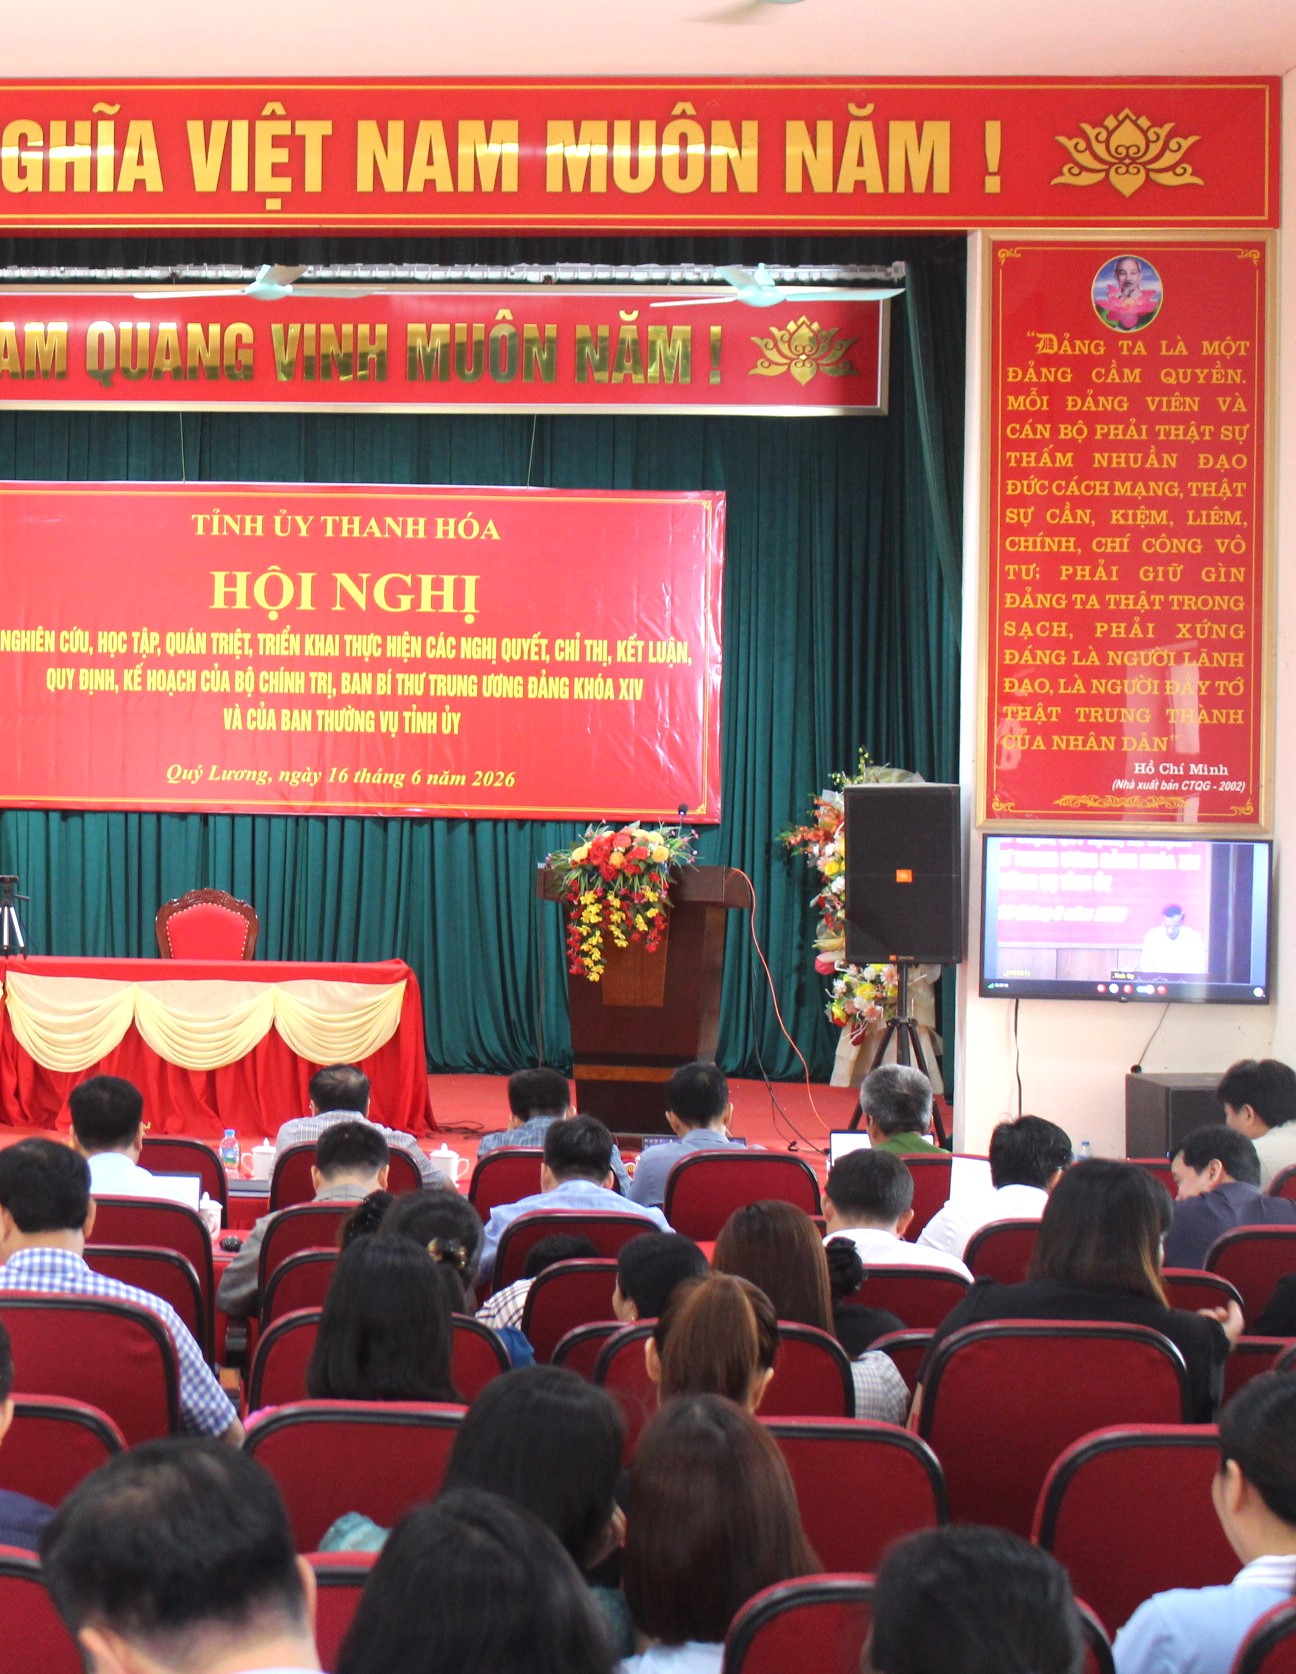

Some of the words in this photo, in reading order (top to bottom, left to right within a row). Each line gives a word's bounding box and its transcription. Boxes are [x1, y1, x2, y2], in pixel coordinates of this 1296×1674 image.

[186, 100, 333, 211] VIỆT
[355, 119, 519, 193] NAM
[545, 100, 759, 194] MUÔN
[784, 102, 951, 194] NĂM
[984, 120, 1002, 194] !
[85, 321, 254, 387] QUANG
[270, 322, 389, 383] VINH
[406, 308, 557, 384] MUÔN
[574, 309, 692, 384] NĂM
[708, 326, 722, 385] !
[1007, 360, 1072, 384] ĐẢNG
[1091, 360, 1141, 384] CẦM
[1008, 388, 1049, 412] MỖI
[1066, 388, 1129, 412] ĐẢNG
[1146, 392, 1199, 412] VIÊN
[1217, 394, 1247, 412] VÀ
[1005, 420, 1052, 440] CÁN
[1057, 420, 1089, 442] BỘ
[1095, 418, 1147, 440] PHẢI
[1155, 421, 1215, 443] THẬT
[1220, 424, 1249, 443] SỰ
[1005, 444, 1074, 468] THẤM
[1093, 446, 1177, 469] NHUẦN
[1200, 453, 1248, 471] ĐẠO
[192, 508, 264, 536] TỈNH
[273, 510, 315, 537] ỦY
[320, 516, 426, 538] THANH
[436, 512, 500, 540] HÓA
[1005, 533, 1081, 553] CHÍNH,
[1092, 534, 1129, 553] CHÍ
[1142, 534, 1202, 554] CÔNG
[1217, 535, 1246, 554] VÔ
[1060, 558, 1119, 582] PHẢI
[1139, 563, 1183, 582] GIỮ
[1202, 564, 1245, 583] GÌN
[209, 565, 316, 621] HỘI
[331, 572, 480, 624] NGHỊ
[1005, 587, 1067, 609] ĐẢNG
[1072, 594, 1100, 609] TA
[1106, 590, 1165, 611] THẬT
[1169, 595, 1244, 610] TRONG
[1004, 620, 1073, 640] SẠCH,
[1094, 616, 1155, 638] PHẢI
[1177, 619, 1245, 640] XỨNG
[0, 627, 55, 652] NGHIÊN
[60, 628, 94, 653] CỨU,
[98, 632, 128, 658] HỌC
[132, 628, 162, 658] TẬP,
[166, 630, 207, 656] QUÁN
[211, 629, 252, 658] TRIỆT,
[258, 626, 301, 655] TRIỂN
[305, 634, 340, 656] KHAI
[345, 634, 382, 660] THỰC
[386, 632, 422, 662] HIỆN
[426, 633, 456, 658] CÁC
[460, 637, 497, 663] NGHỊ
[502, 633, 550, 662] QUYẾT,
[555, 632, 580, 660] CHỈ
[585, 640, 611, 664] THỊ,
[617, 638, 643, 662] KẾT
[649, 636, 692, 669] LUẬN,
[46, 668, 74, 690] QUY
[79, 669, 118, 694] ĐỊNH,
[124, 665, 142, 691] KẾ
[148, 670, 196, 696] HOẠCH
[201, 664, 230, 691] CỦA
[235, 668, 255, 693] BỘ
[259, 669, 306, 693] CHÍNH
[310, 672, 337, 697] TRỊ,
[342, 672, 373, 694] BAN
[376, 671, 392, 695] BÍ
[396, 672, 427, 696] THƯ
[428, 674, 478, 697] TRUNG
[482, 674, 524, 698] ƯƠNG
[527, 670, 570, 698] ĐẢNG
[574, 676, 614, 699] KHÓA
[620, 679, 642, 699] XIV
[224, 708, 242, 729] VÀ
[248, 703, 276, 730] CỦA
[281, 710, 312, 730] BAN
[317, 706, 376, 732] THƯỜNG
[380, 712, 399, 736] VỤ
[403, 704, 438, 734] TỈNH
[442, 706, 461, 734] ỦY
[166, 764, 204, 784] Quý
[208, 765, 272, 785] Lương,
[278, 768, 323, 787] ngày
[328, 768, 350, 784] 16
[353, 768, 406, 789] tháng
[410, 770, 422, 784] 6
[426, 770, 468, 786] năm
[471, 770, 516, 788] 2026
[1134, 760, 1154, 774] Hồ
[1159, 763, 1184, 775] Chí
[1189, 764, 1228, 775] Minh
